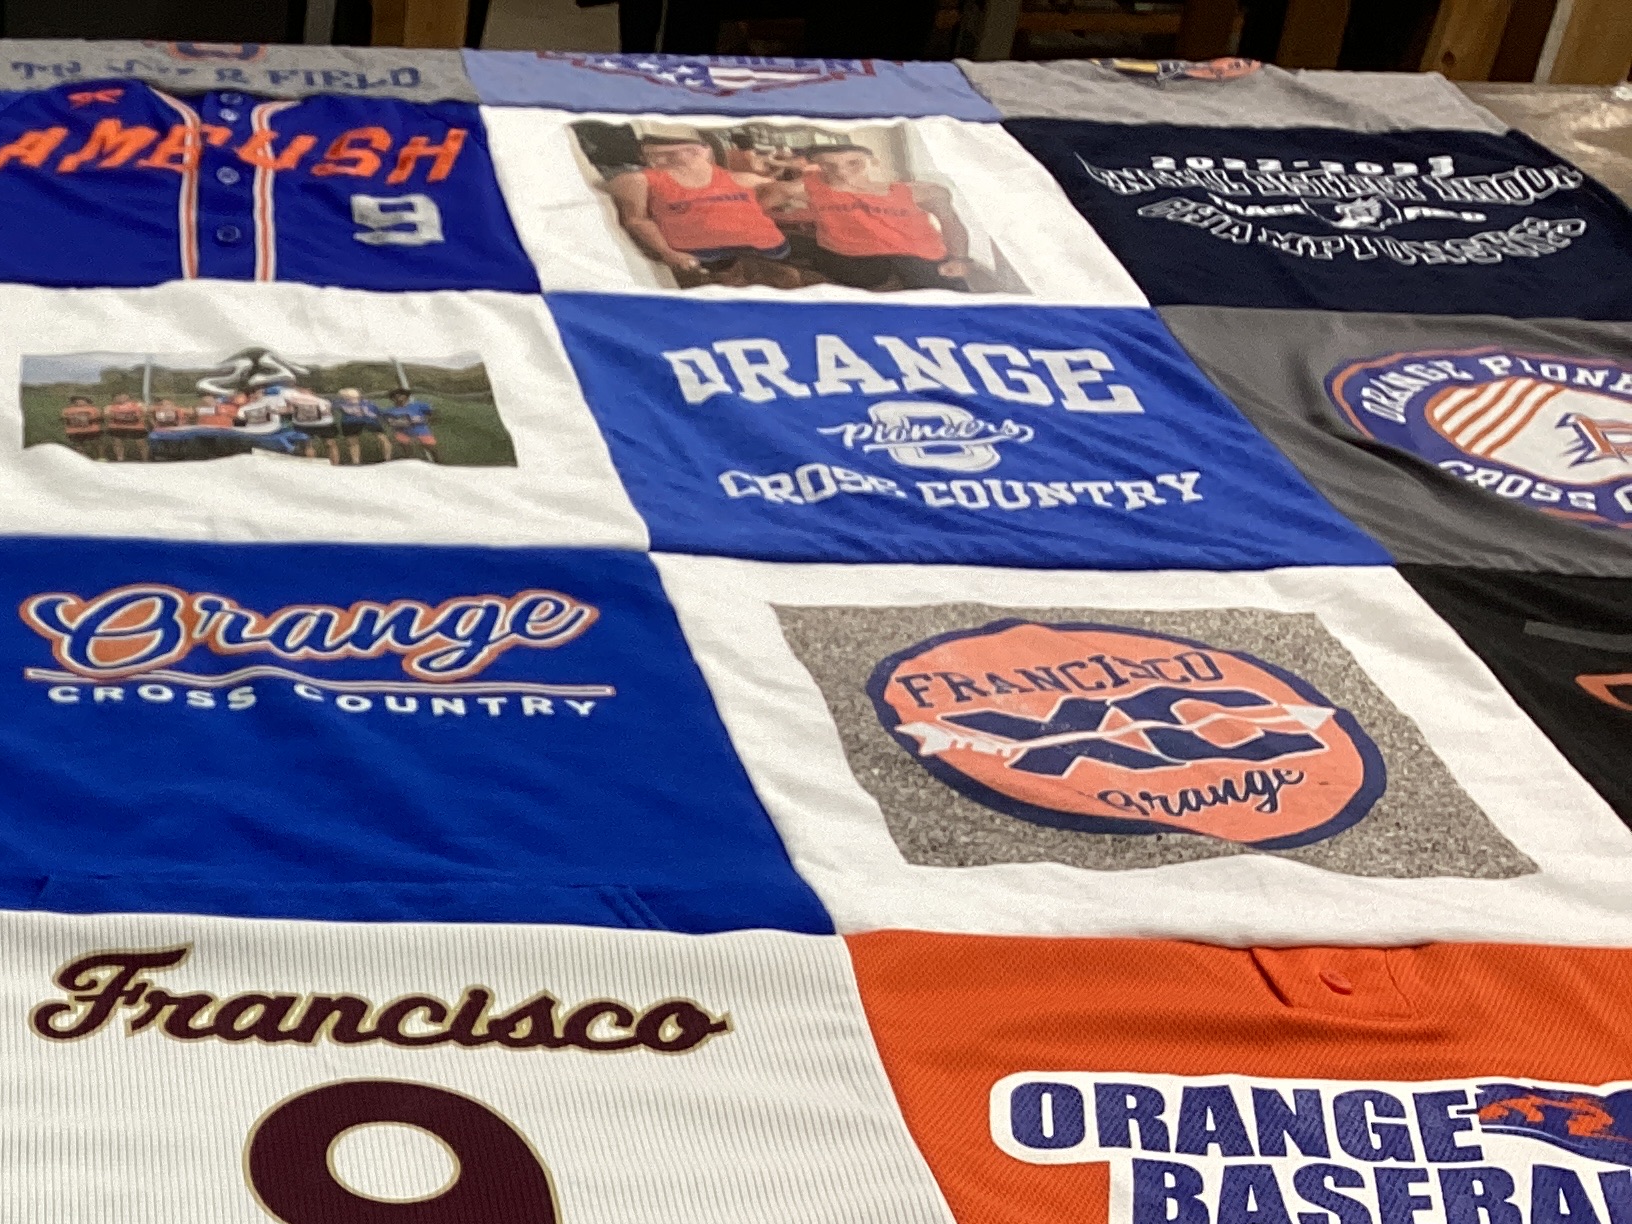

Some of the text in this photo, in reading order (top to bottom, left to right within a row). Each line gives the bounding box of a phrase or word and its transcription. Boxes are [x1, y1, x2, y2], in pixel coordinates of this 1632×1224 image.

[350, 193, 445, 245] 9
[661, 334, 1145, 414] ORANGE
[1361, 359, 1474, 425] ORANGE
[917, 471, 1204, 511] COUNTRY
[20, 582, 599, 680] Orange
[48, 682, 596, 717] CROSS COUNTRY
[895, 651, 1226, 708] FRANCISCO
[28, 942, 734, 1056] Francisco
[1009, 1081, 1484, 1162] ORANGE
